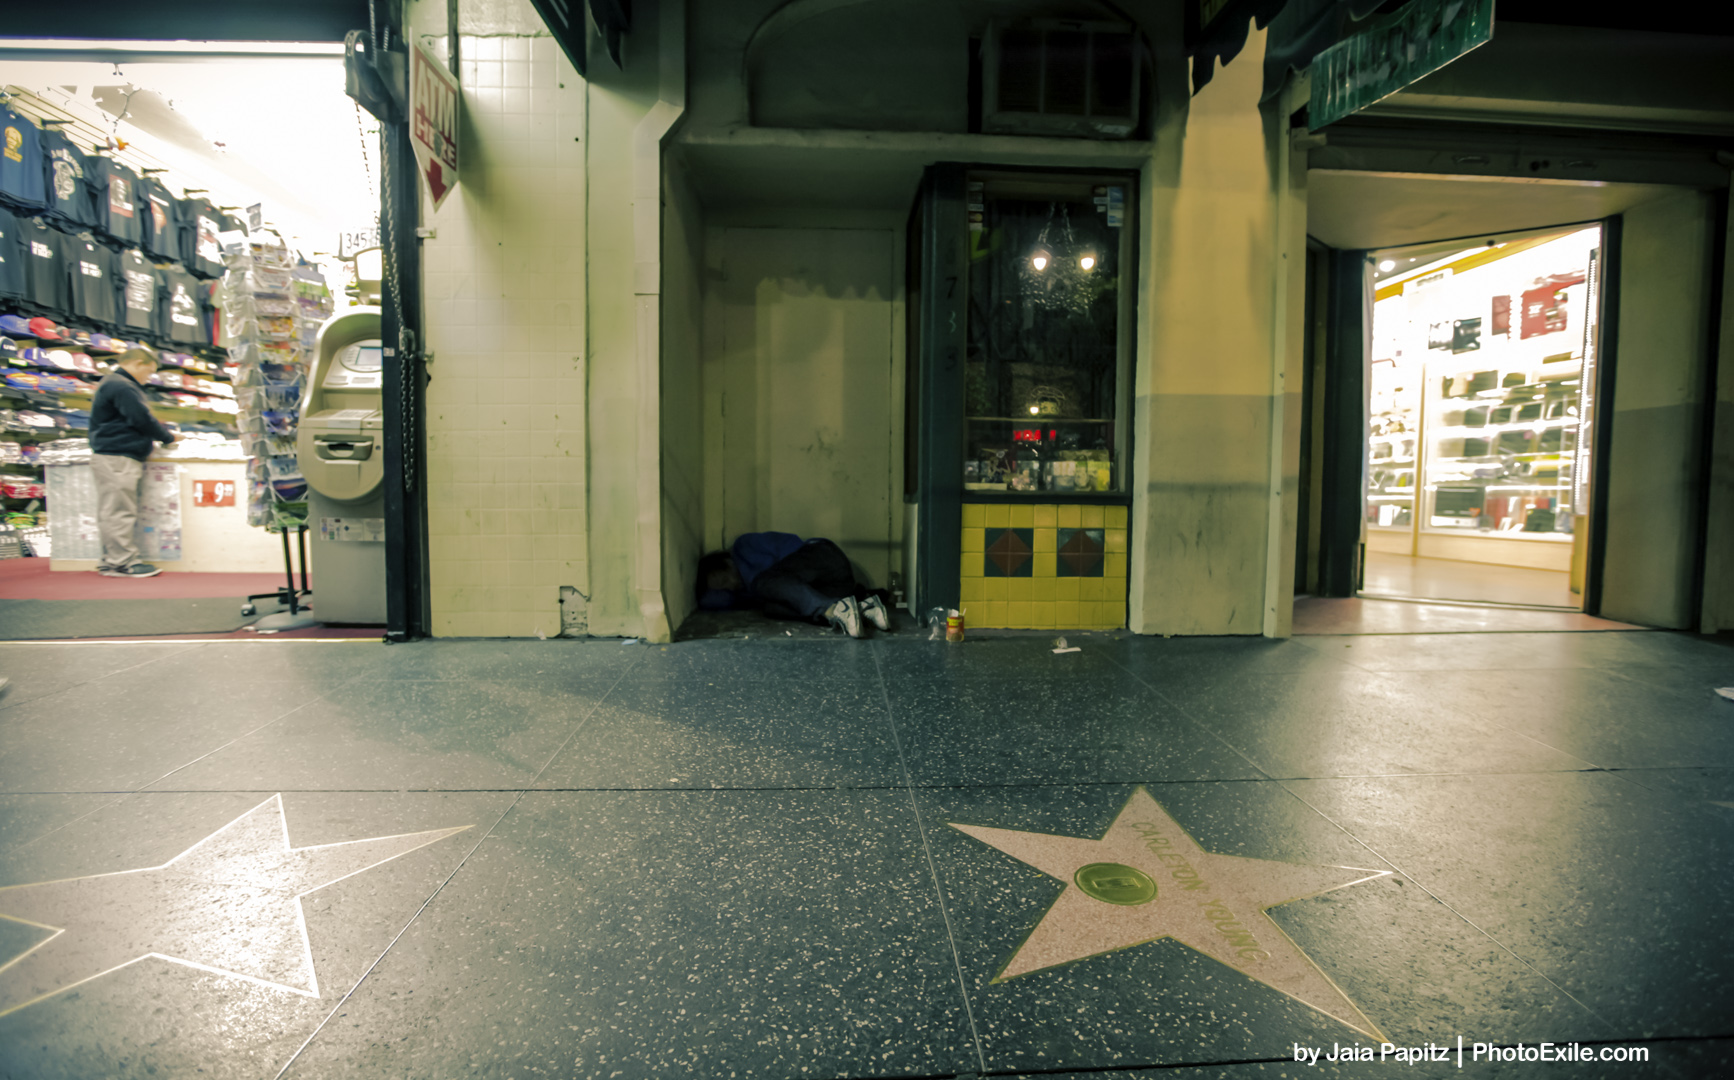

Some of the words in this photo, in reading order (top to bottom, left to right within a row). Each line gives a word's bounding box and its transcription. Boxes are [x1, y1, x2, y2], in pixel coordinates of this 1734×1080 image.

[415, 57, 457, 145] ATM
[1131, 822, 1210, 894] CARLETON
[1199, 899, 1271, 961] YOUNG
